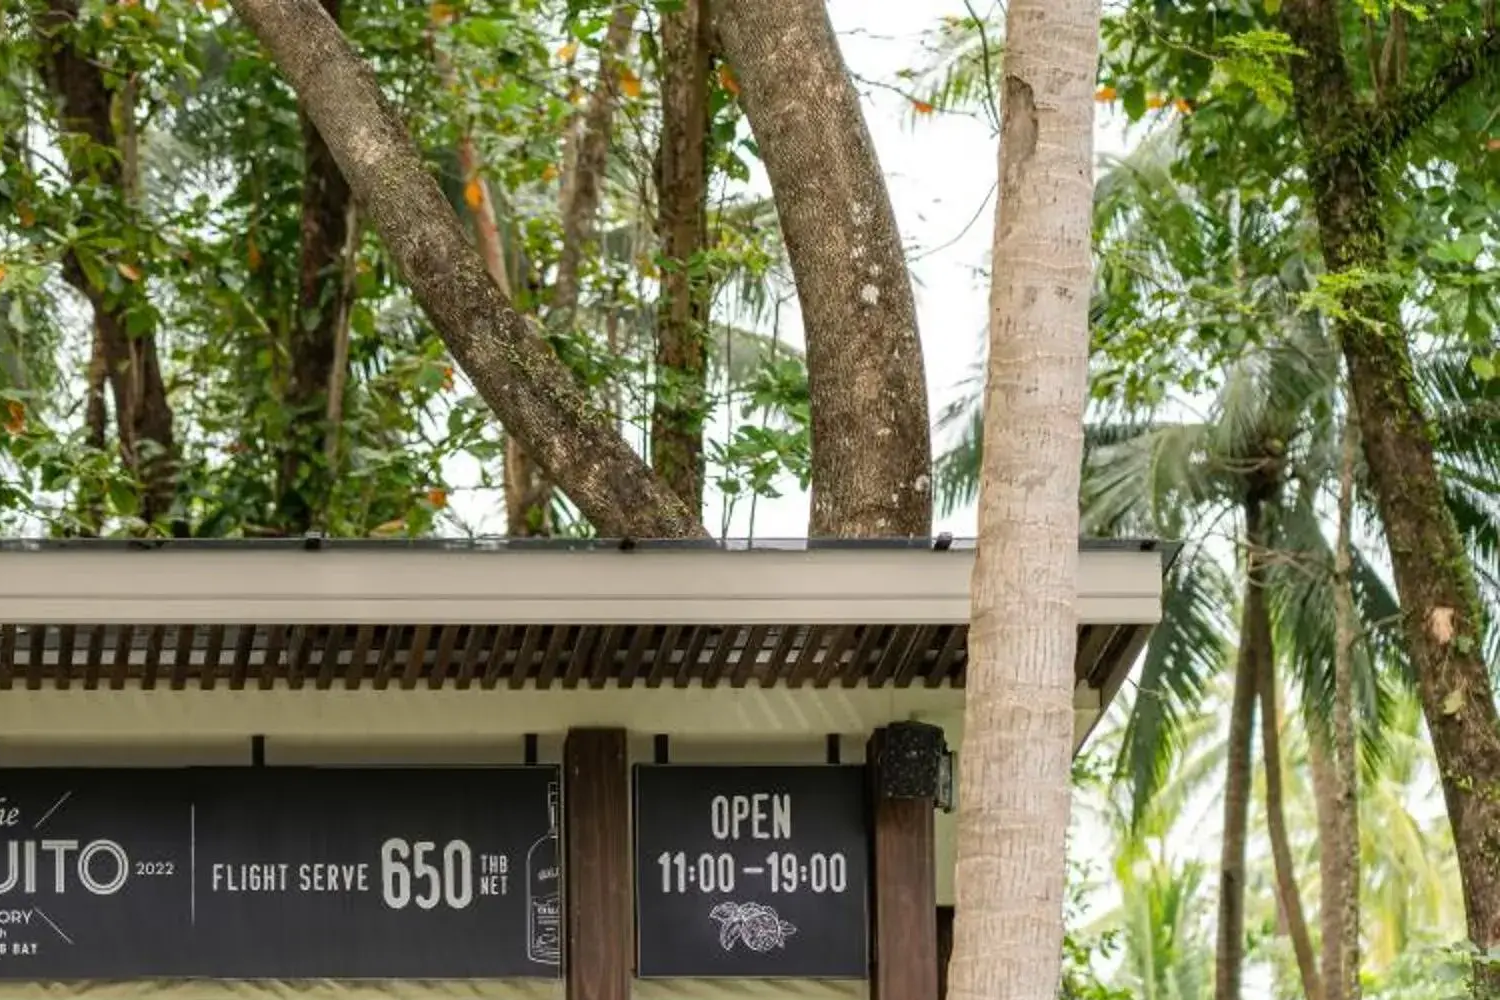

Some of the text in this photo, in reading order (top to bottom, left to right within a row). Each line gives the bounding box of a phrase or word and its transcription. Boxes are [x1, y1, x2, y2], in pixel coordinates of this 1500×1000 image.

[711, 794, 791, 839] OPEN
[136, 862, 175, 875] 2022
[213, 838, 474, 909] FLIGHT SERVE 650
[480, 854, 508, 873] THB
[480, 875, 508, 896] NET
